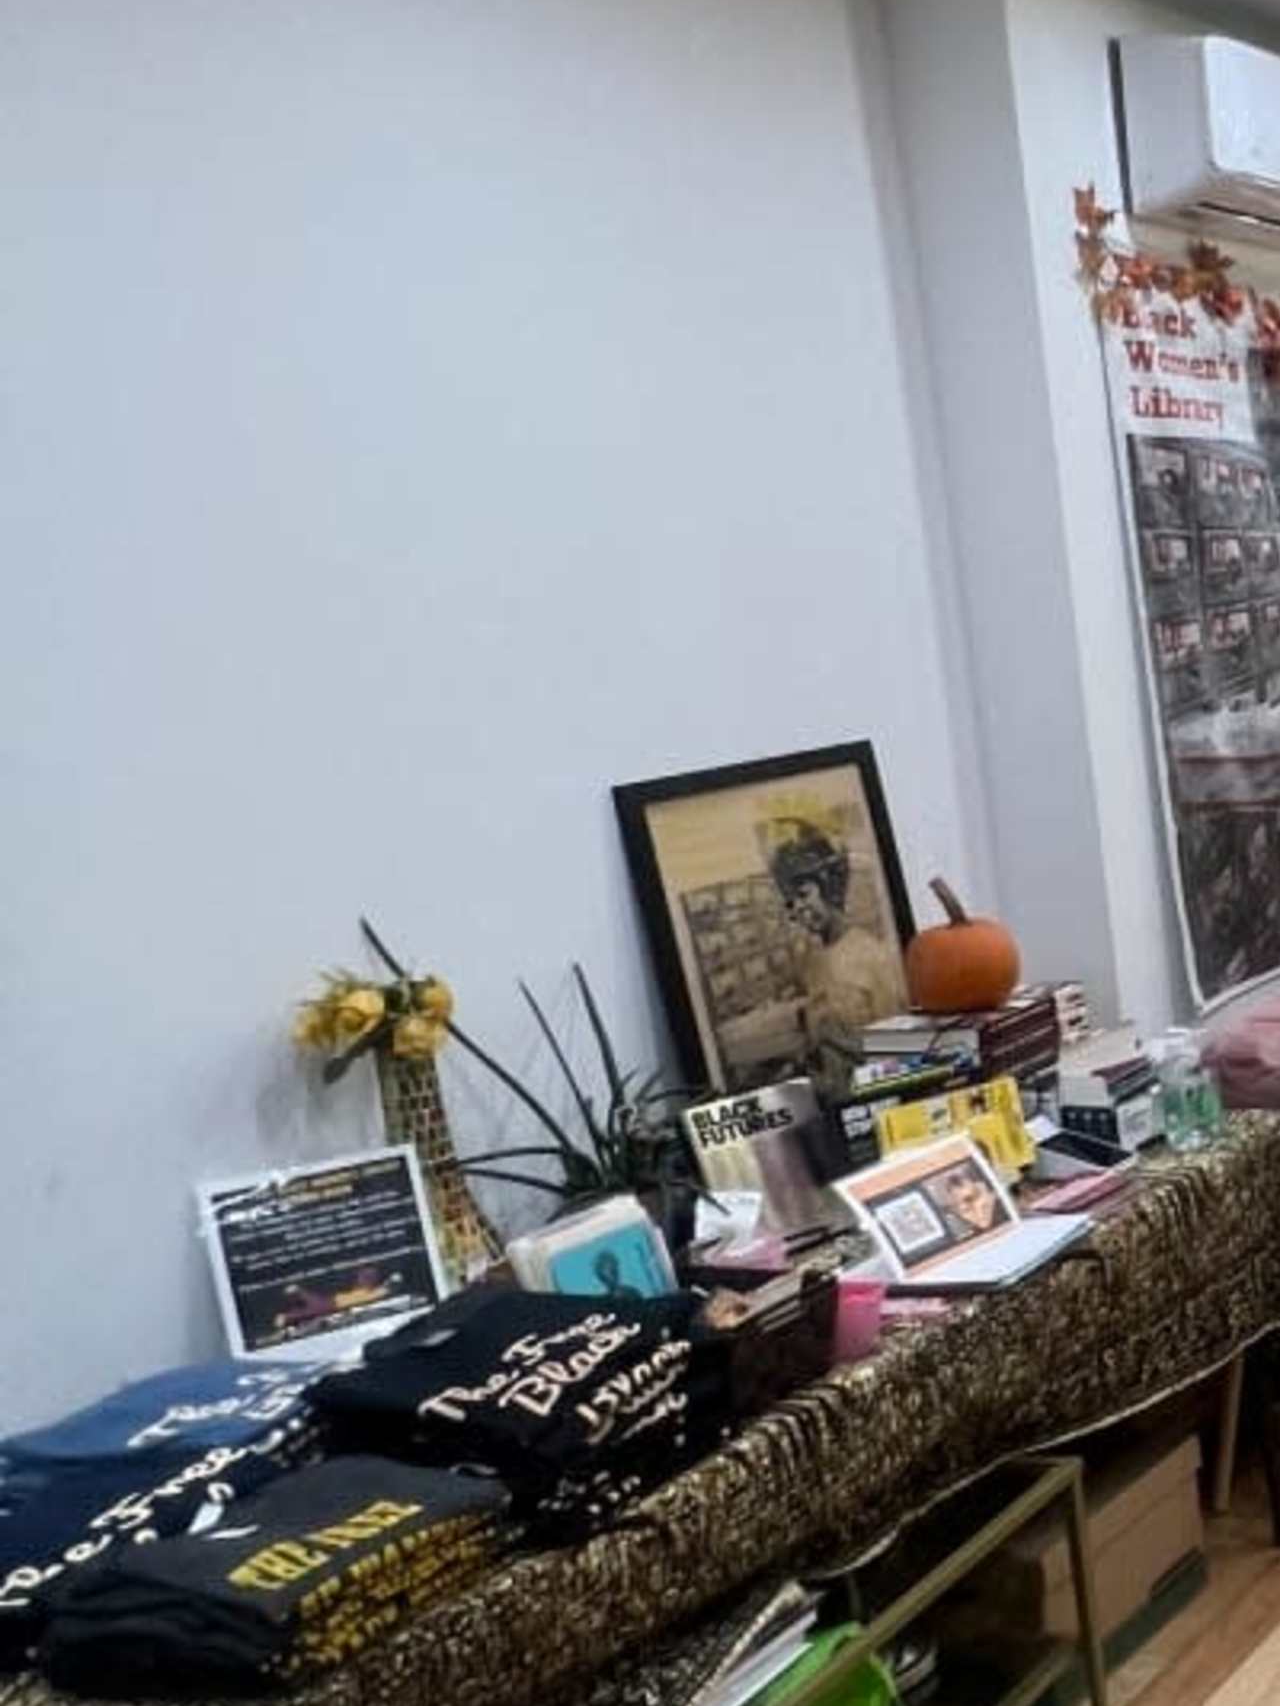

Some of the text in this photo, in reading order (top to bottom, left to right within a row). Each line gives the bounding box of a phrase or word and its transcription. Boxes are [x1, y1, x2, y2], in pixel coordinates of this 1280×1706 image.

[1121, 303, 1197, 339] Back
[1123, 339, 1240, 383] Women's
[1129, 385, 1224, 430] Library
[691, 1096, 764, 1131] BLACK
[699, 1108, 794, 1148] FUTURES
